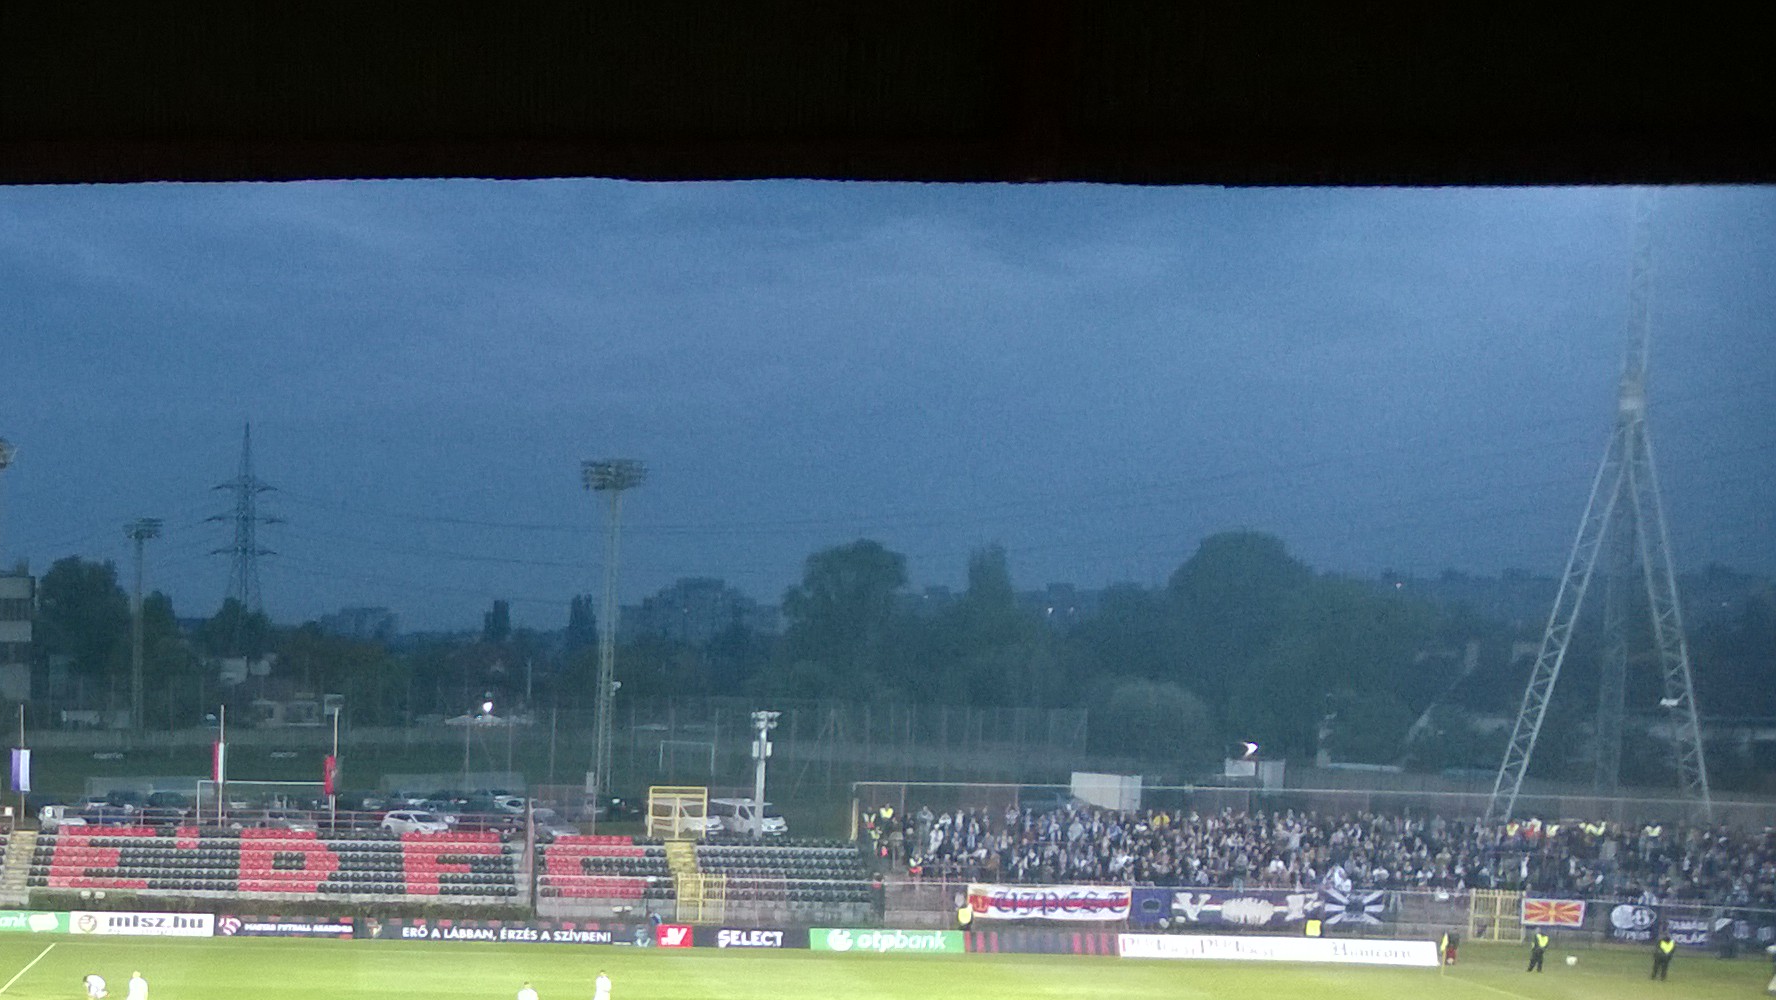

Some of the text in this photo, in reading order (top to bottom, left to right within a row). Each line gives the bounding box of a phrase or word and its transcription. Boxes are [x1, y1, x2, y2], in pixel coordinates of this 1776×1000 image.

[108, 914, 204, 929] mlsz.hu
[431, 928, 441, 939] A
[541, 930, 551, 941] A
[717, 929, 784, 948] SELECT
[857, 930, 947, 953] otpbank
